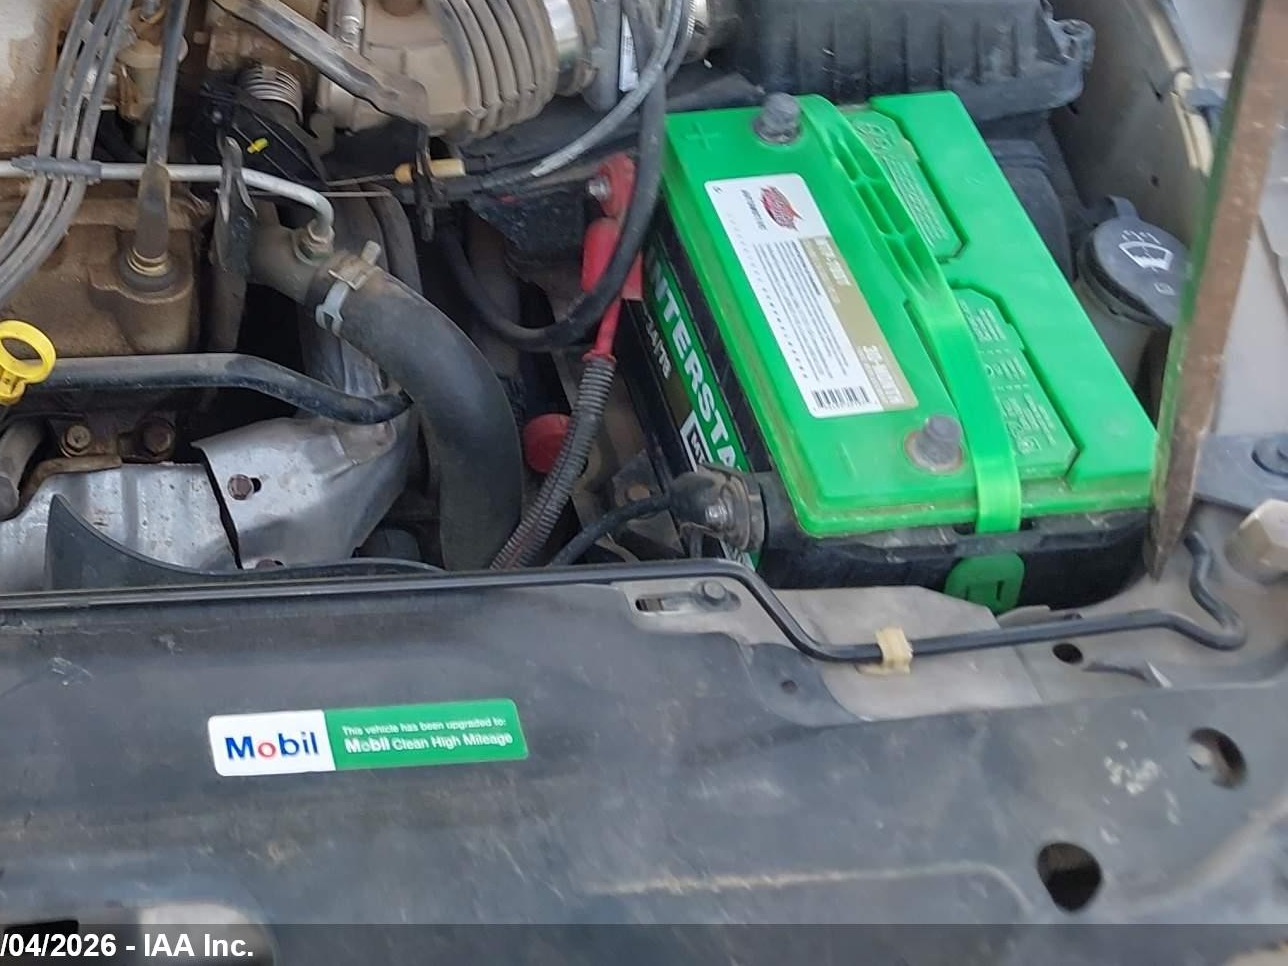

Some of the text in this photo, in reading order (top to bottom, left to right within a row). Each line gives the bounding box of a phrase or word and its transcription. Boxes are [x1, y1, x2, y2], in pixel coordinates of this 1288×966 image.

[342, 717, 507, 736] This vehicle has been upgraded to:
[224, 731, 319, 760] Mobil
[344, 732, 513, 753] Mobil Clean High Mileage
